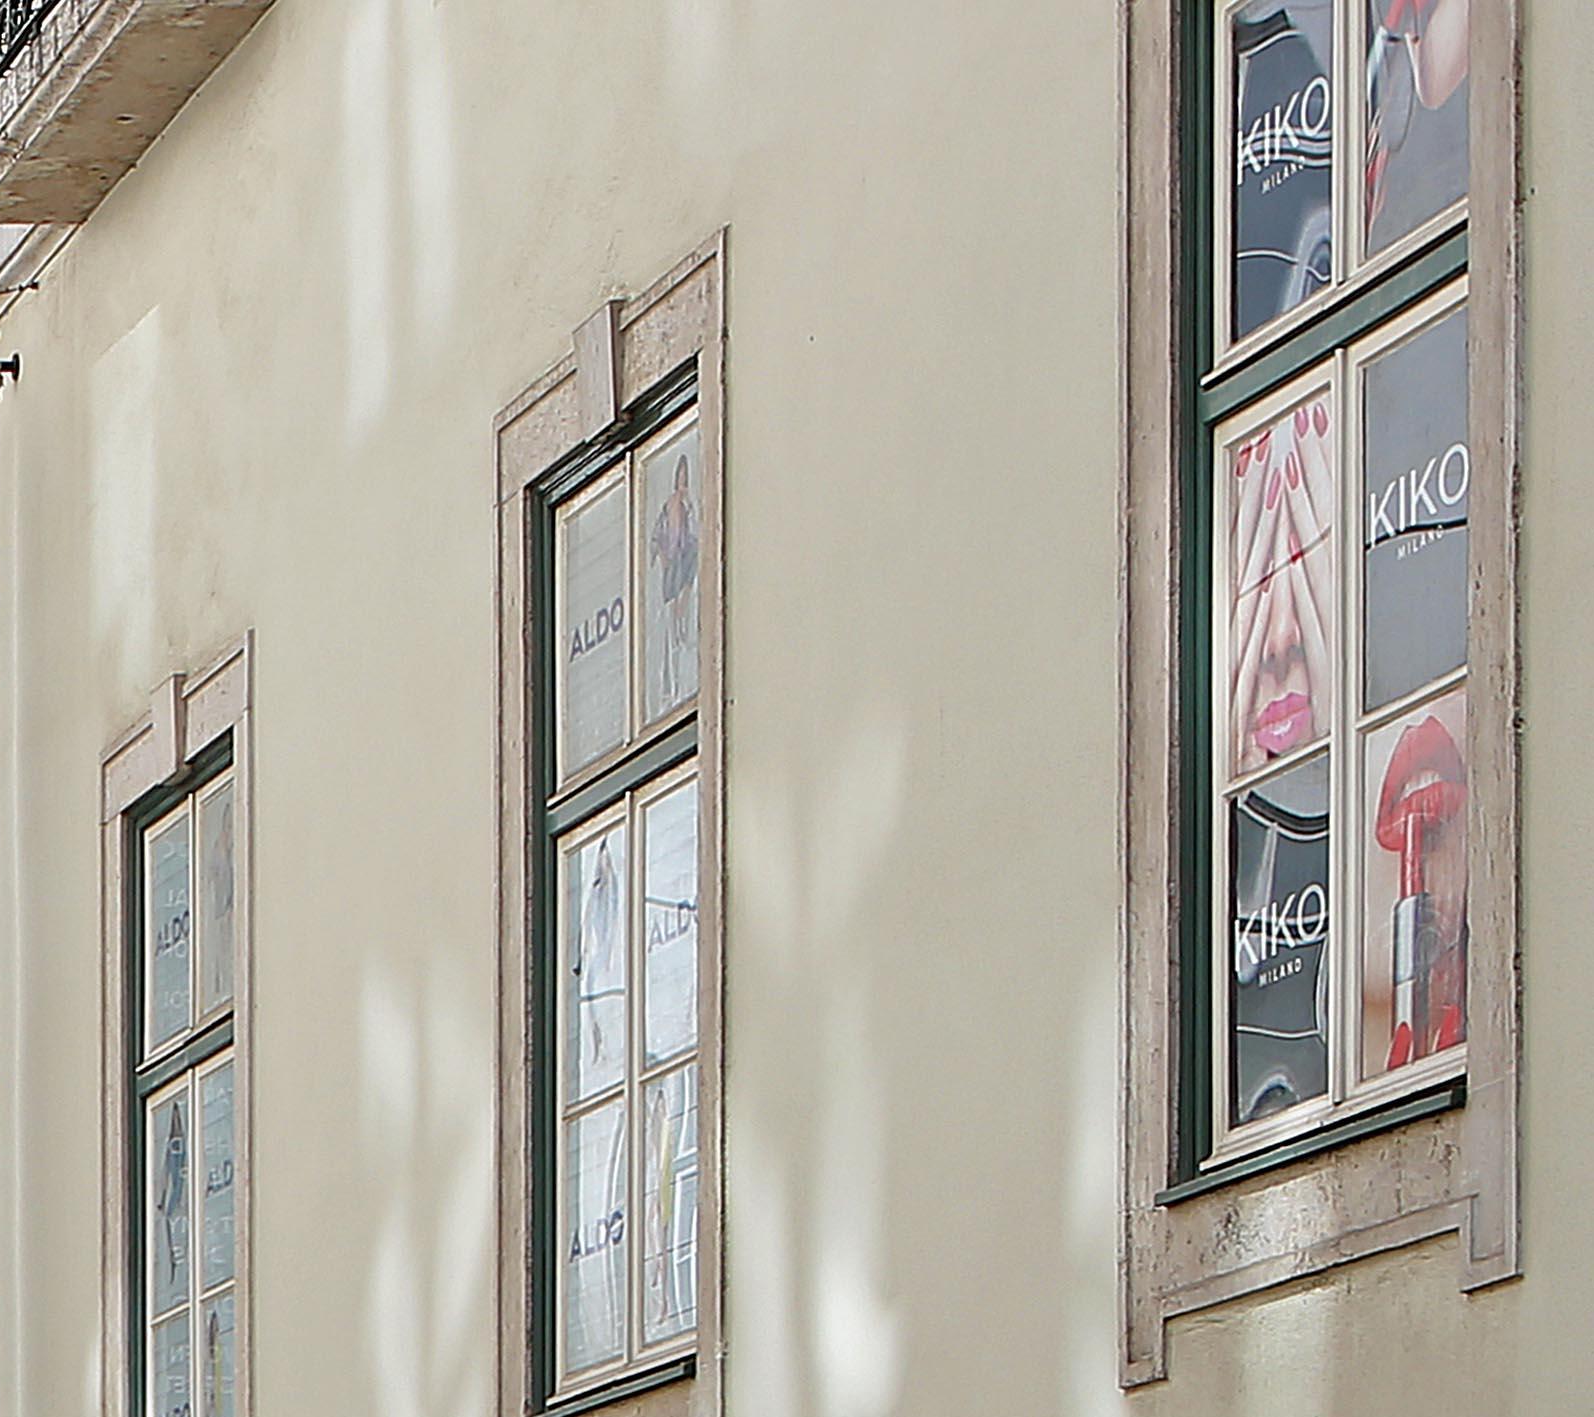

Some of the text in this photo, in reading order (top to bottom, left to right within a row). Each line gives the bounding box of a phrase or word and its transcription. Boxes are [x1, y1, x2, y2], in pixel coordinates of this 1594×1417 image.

[1237, 76, 1330, 185] KIKO
[1370, 443, 1469, 548] KIKO
[1398, 524, 1443, 560] MILANO
[570, 597, 624, 663] ALDO
[648, 900, 699, 953] ALD
[1235, 884, 1326, 972] KIKO
[1259, 957, 1302, 988] MILANO
[569, 1209, 625, 1263] ALDO
